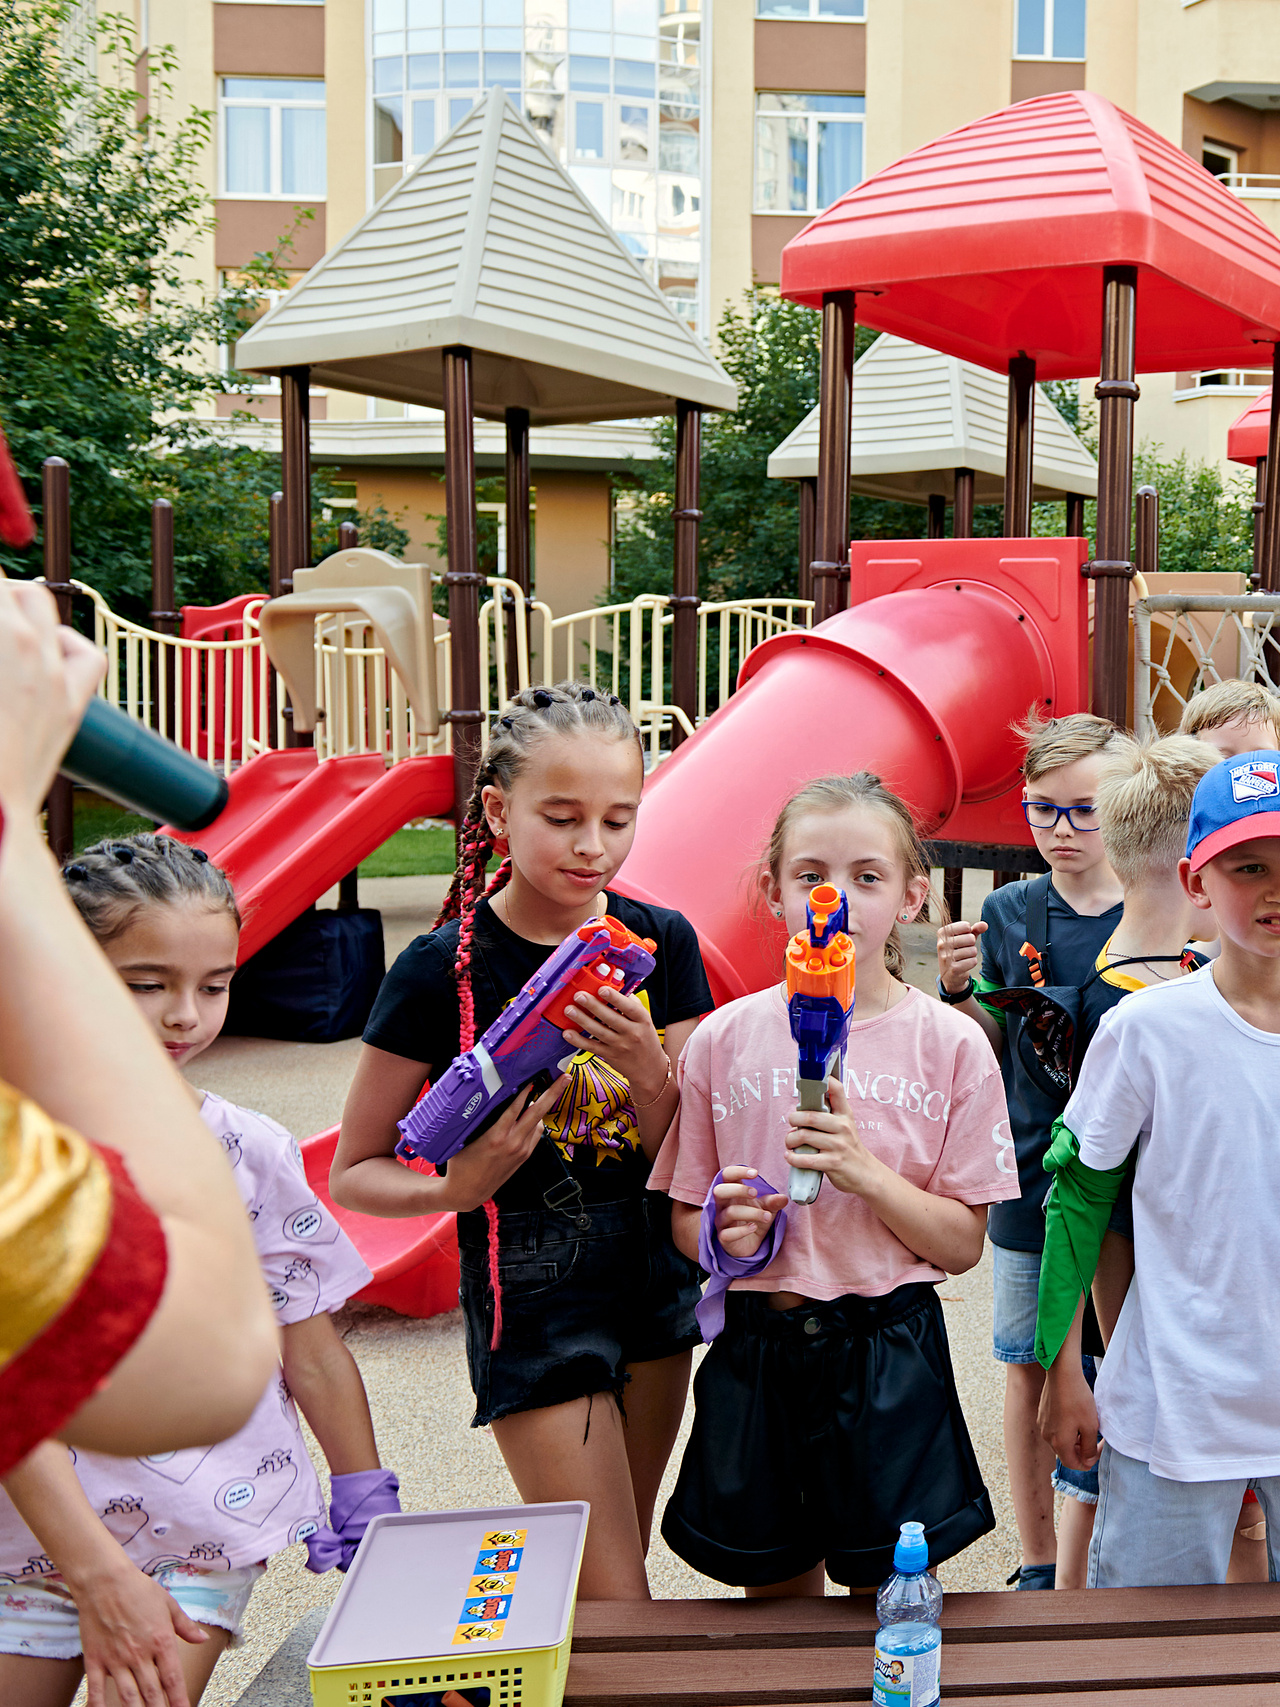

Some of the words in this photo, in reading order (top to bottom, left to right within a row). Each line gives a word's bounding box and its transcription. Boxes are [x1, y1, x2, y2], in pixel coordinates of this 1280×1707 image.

[461, 1091, 483, 1119] NERF
[712, 1072, 762, 1123] SAN
[771, 1067, 951, 1123] FNCISC
